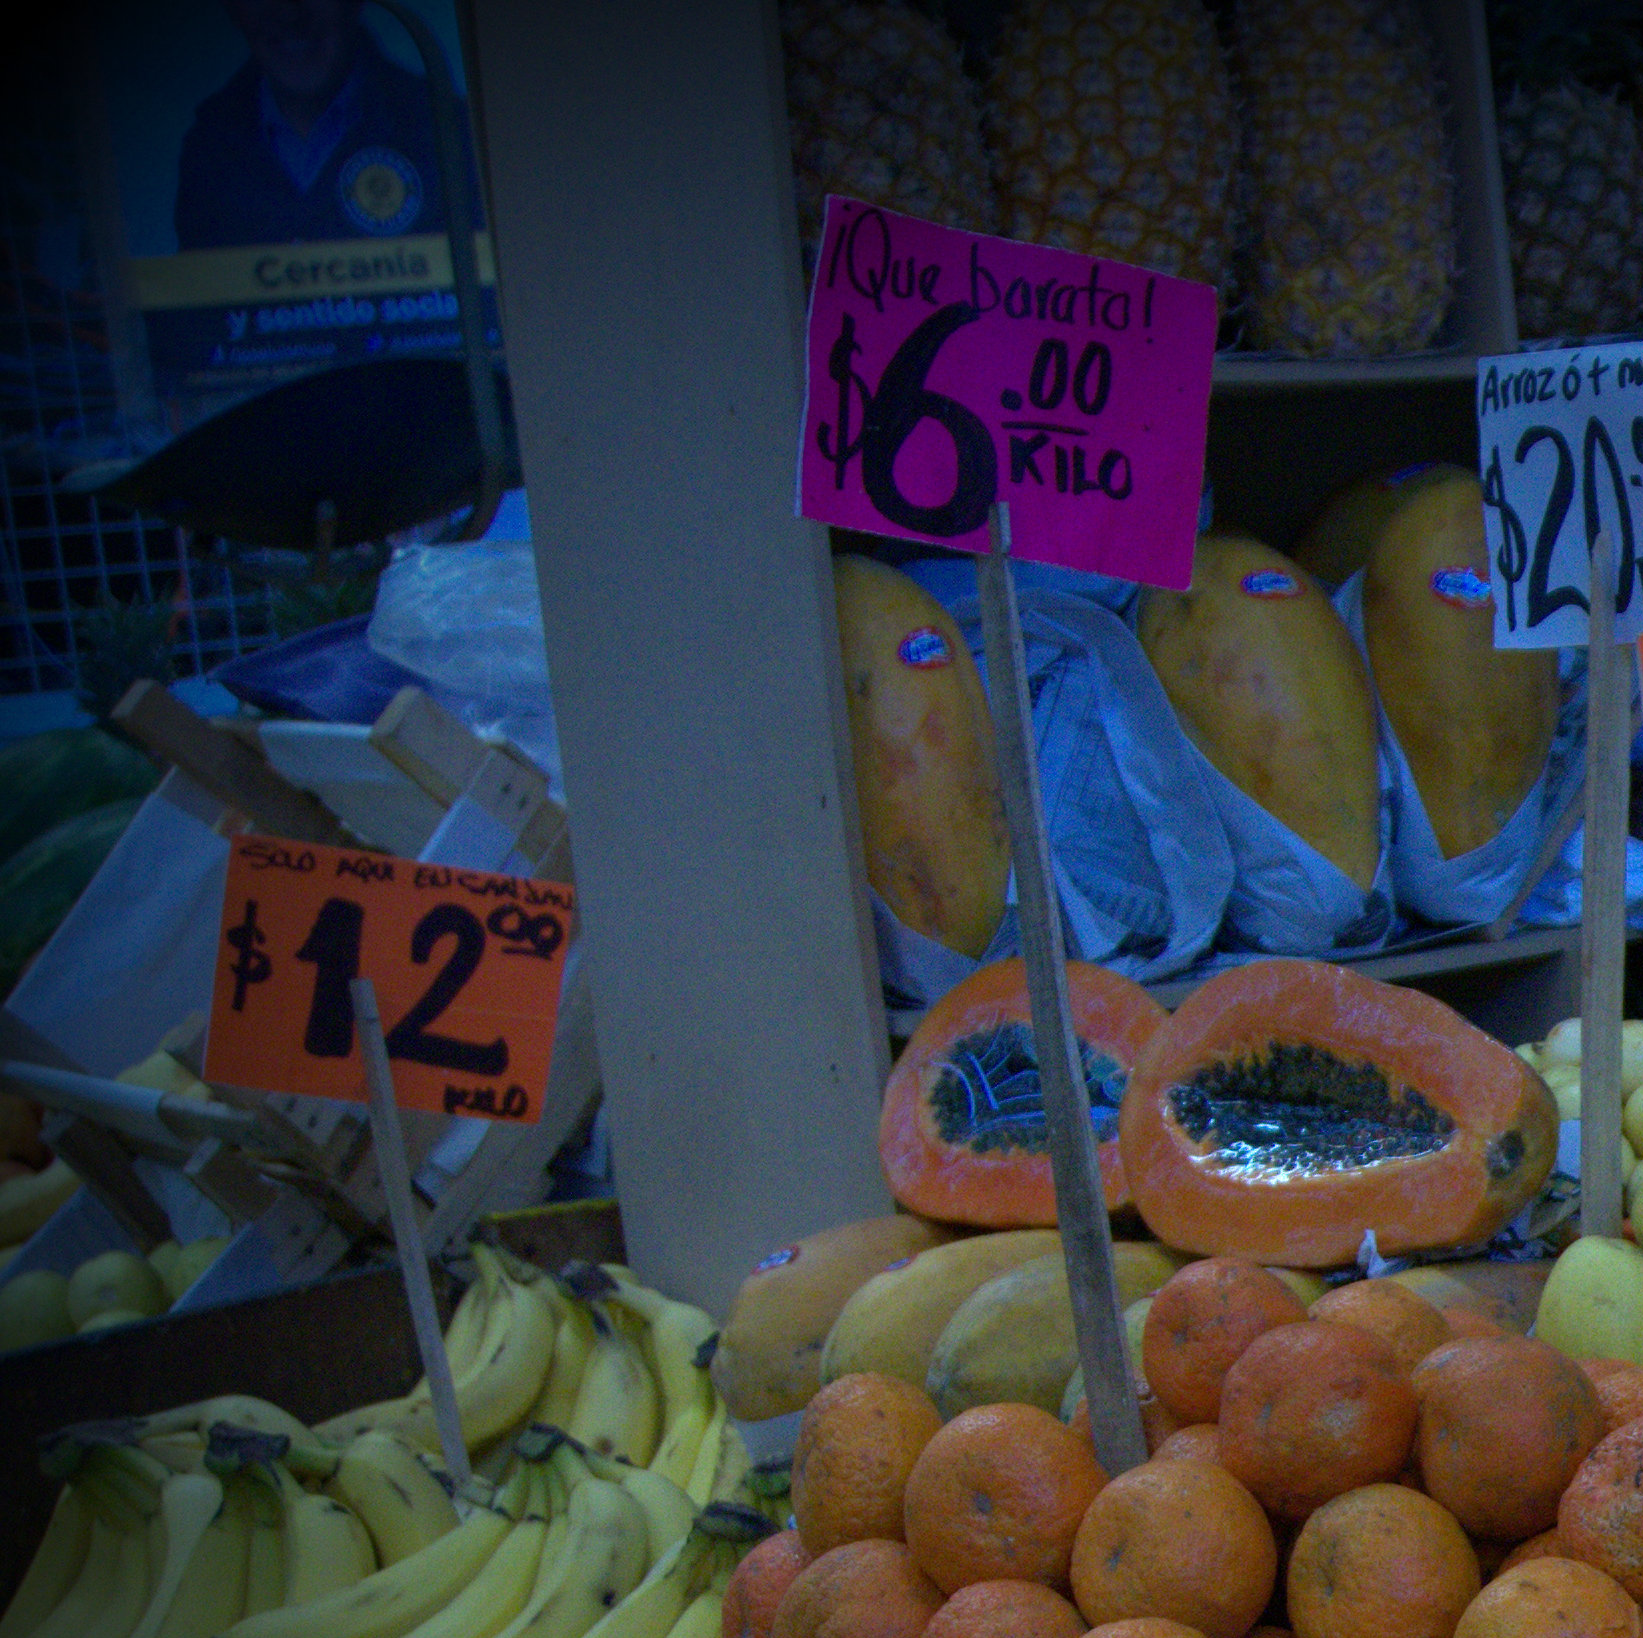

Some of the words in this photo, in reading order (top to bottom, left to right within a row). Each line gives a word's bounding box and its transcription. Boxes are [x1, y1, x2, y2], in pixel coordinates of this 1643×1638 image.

[254, 249, 430, 288] Cercanía
[827, 202, 942, 313] ¡Que
[225, 308, 250, 343] y
[255, 295, 376, 335] sentido
[381, 290, 461, 325] socia
[1480, 363, 1557, 416] Arroz
[1010, 433, 1133, 500] KILO
[335, 853, 396, 883] AQUI
